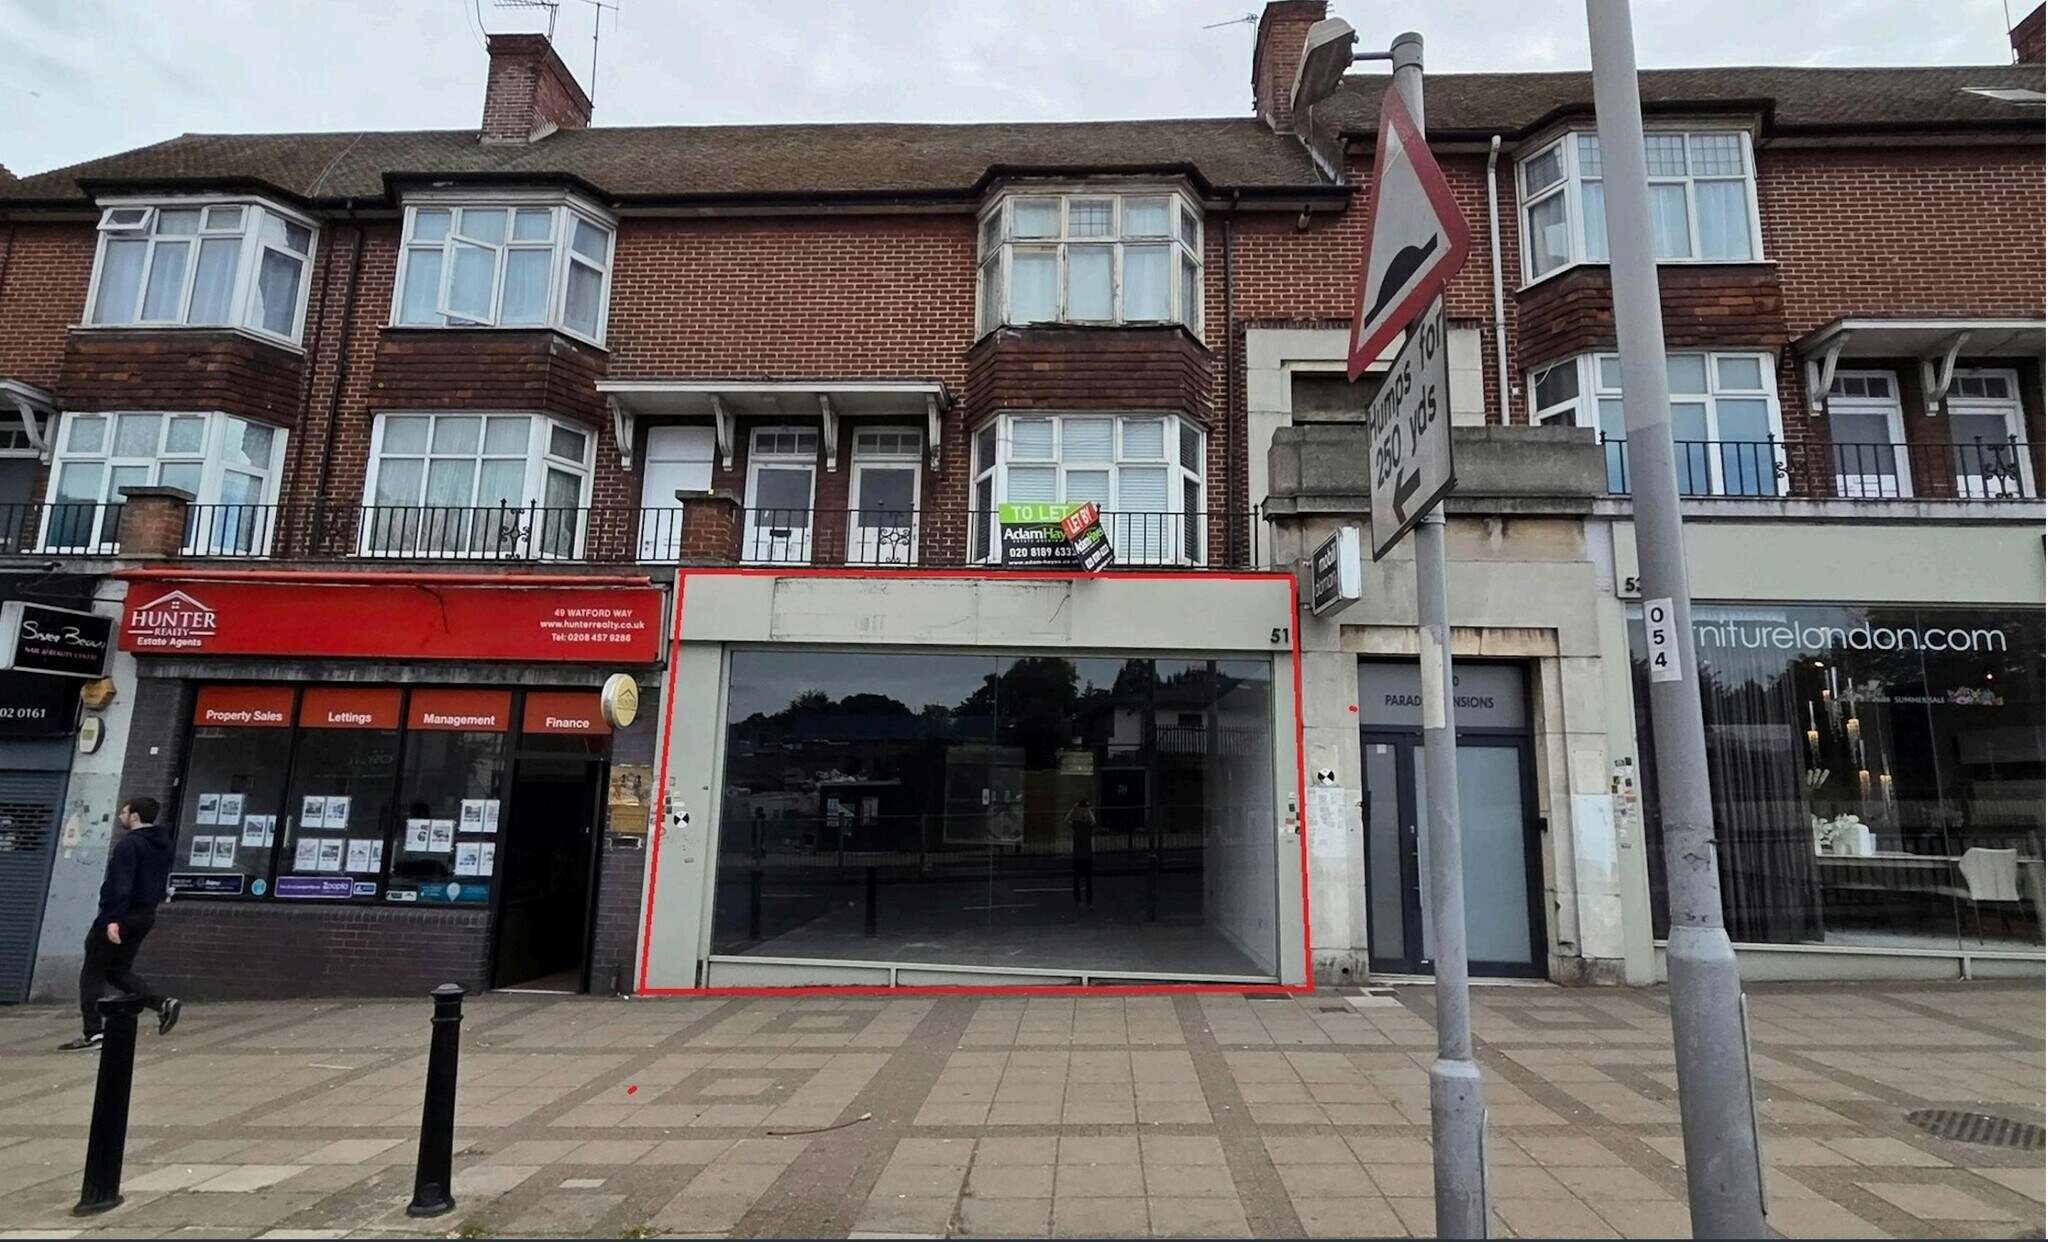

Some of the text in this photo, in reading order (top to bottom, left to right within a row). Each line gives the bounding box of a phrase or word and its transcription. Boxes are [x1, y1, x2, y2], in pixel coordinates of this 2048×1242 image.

[1368, 310, 1441, 447] Humps for
[1376, 384, 1436, 490] 250 yds
[1010, 505, 1070, 520] TO LET
[1067, 506, 1093, 534] LET BY
[1003, 527, 1067, 543] AdamHay
[1009, 548, 1028, 557] 020
[1030, 547, 1052, 557] 8189
[554, 608, 633, 617] 49 WATFORD WAY
[131, 611, 216, 628] HUNTER
[540, 620, 645, 630] www.hunterrealty.co.uk
[154, 627, 189, 636] REALTY
[552, 633, 567, 641] Tel:
[567, 633, 590, 641] 0208
[1270, 628, 1289, 643] 51
[137, 636, 202, 648] Estate Agents
[1385, 695, 1494, 709] PARAD NSIONS
[17, 708, 46, 718] 0161
[206, 710, 283, 722] Property Sales
[328, 712, 372, 725] Lettings
[423, 713, 496, 727] Management
[545, 717, 590, 729] Finance
[322, 881, 349, 891] Zoopla
